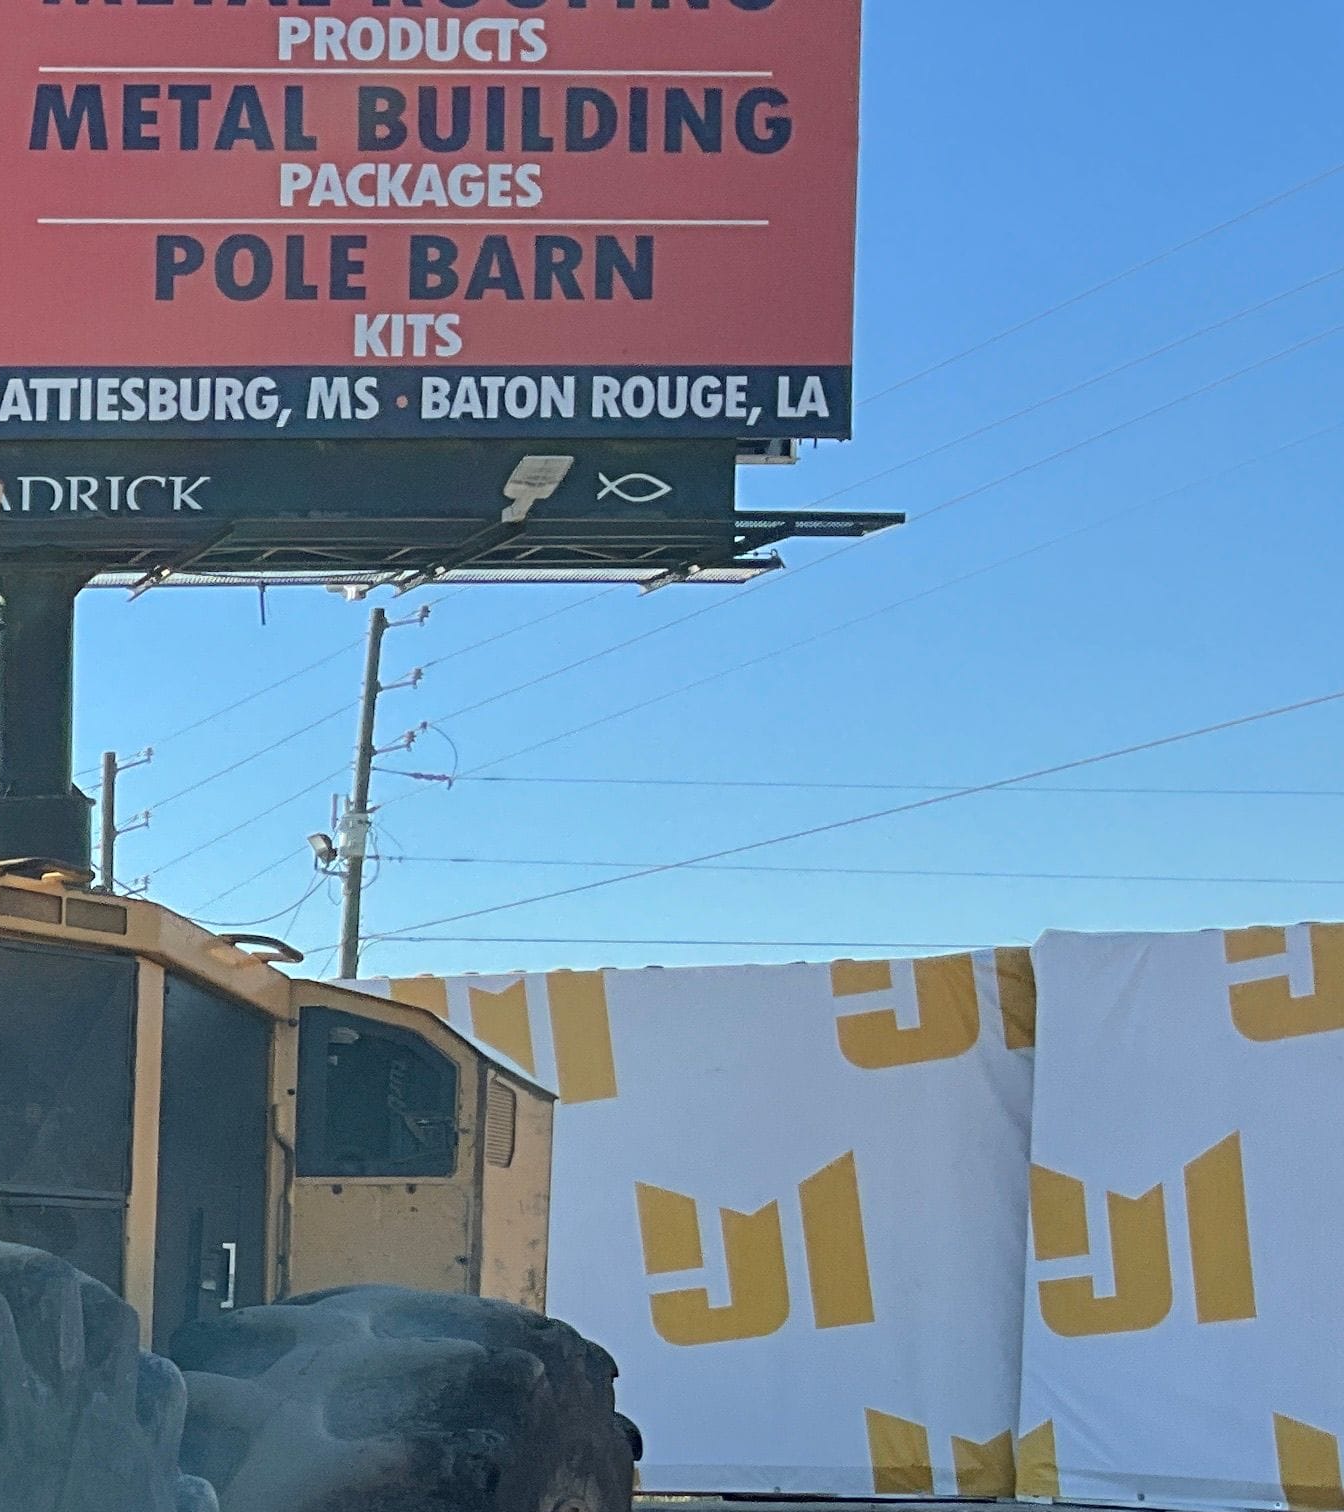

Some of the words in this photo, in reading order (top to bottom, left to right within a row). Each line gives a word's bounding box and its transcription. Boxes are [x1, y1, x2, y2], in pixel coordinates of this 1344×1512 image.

[278, 16, 548, 63] PRODUCTS
[28, 84, 318, 152] METAL
[357, 86, 794, 155] BUILDING
[279, 162, 543, 208] PACKAGES
[155, 234, 369, 301] POLE
[408, 235, 655, 301] BARN
[354, 313, 463, 357] KITS
[306, 376, 379, 421] MS
[421, 375, 575, 420] BATON
[592, 376, 762, 426] ROUGE,
[777, 376, 829, 418] LA
